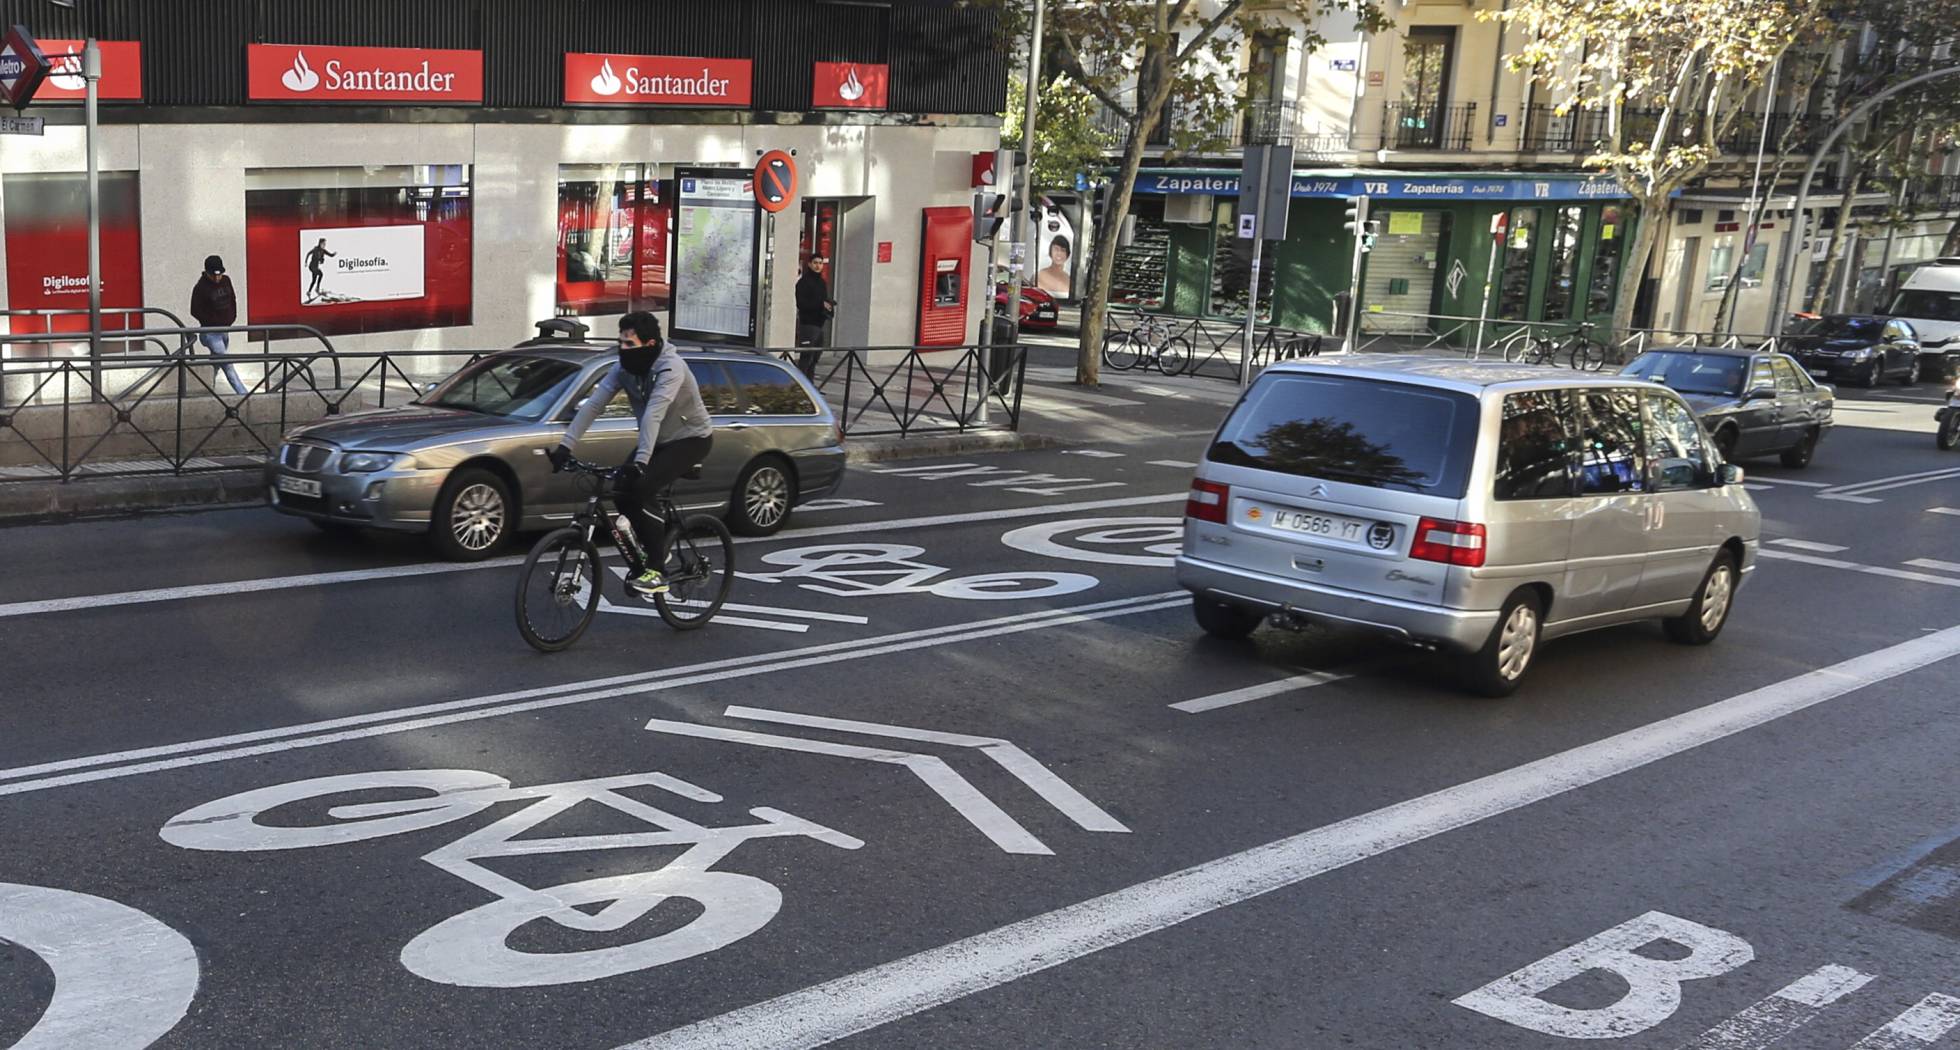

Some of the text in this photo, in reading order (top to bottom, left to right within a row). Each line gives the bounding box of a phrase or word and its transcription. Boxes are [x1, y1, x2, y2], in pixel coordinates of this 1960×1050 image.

[325, 60, 454, 92] Santander
[625, 67, 729, 96] Santander
[1313, 182, 1337, 193] 1974
[1364, 183, 1389, 194] VR
[1403, 183, 1464, 195] Zapaterías
[1535, 183, 1549, 198] VR
[339, 257, 388, 271] Digilosofía.
[871, 462, 1128, 496] TAXI
